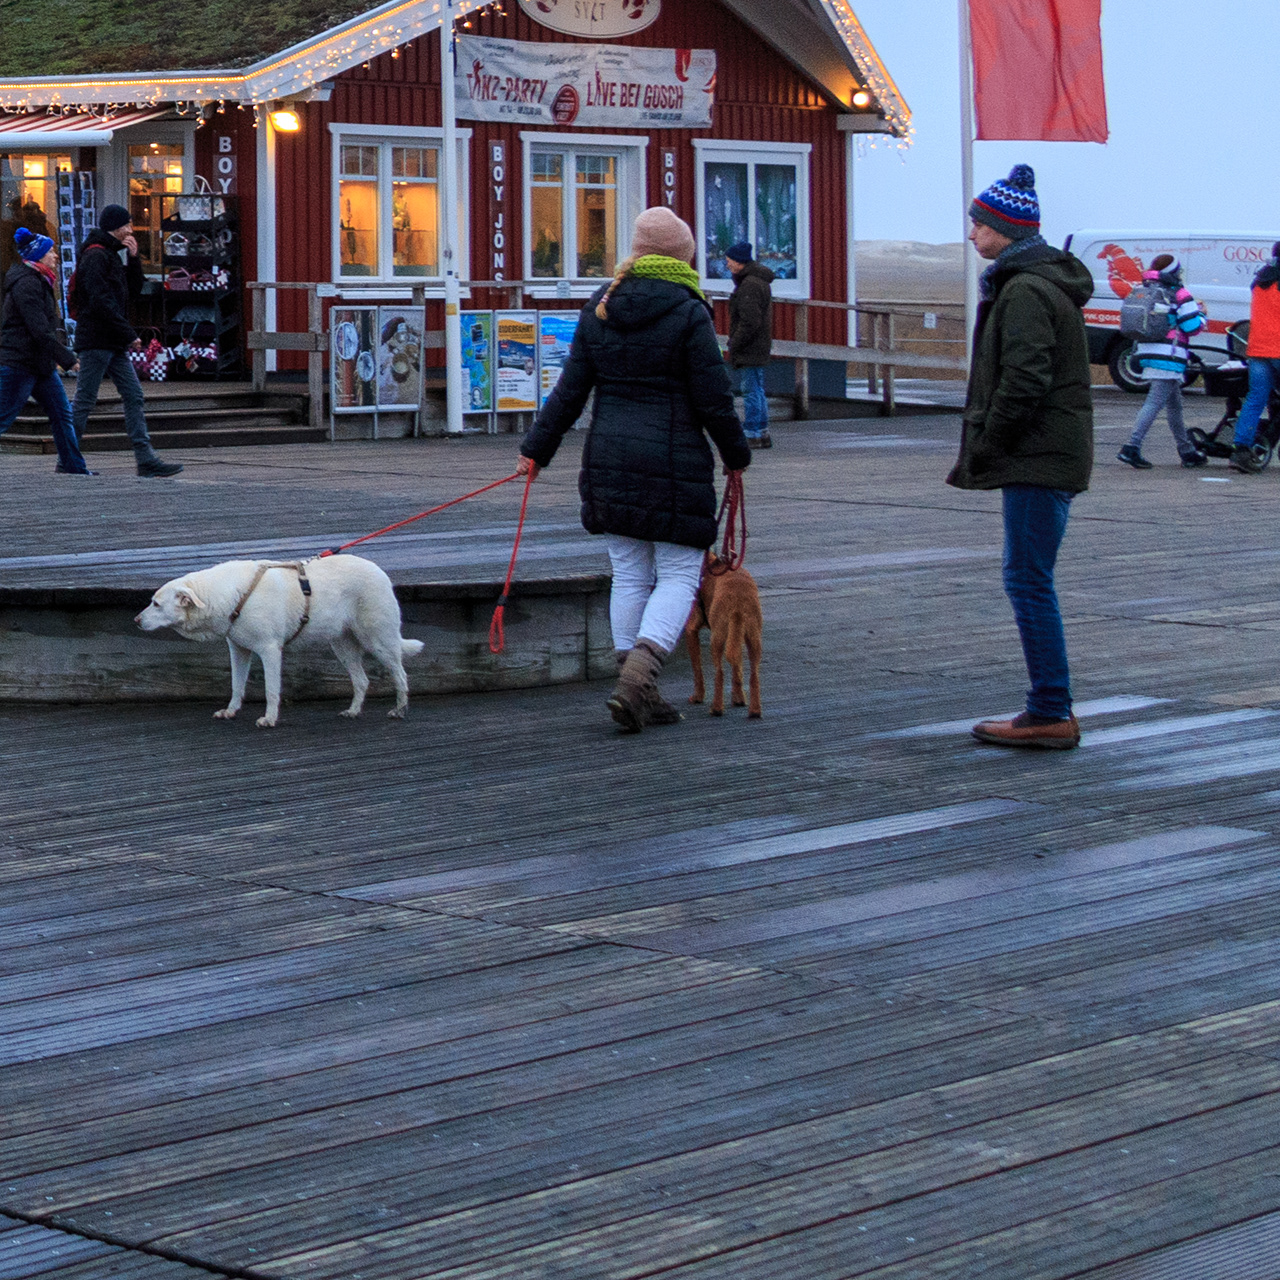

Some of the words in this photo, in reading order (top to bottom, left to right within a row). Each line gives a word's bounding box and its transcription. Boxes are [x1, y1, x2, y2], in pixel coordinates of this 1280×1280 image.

[574, 0, 606, 22] SYLT
[620, 82, 641, 108] BEI
[643, 83, 684, 109] GOSCH
[493, 146, 503, 201] BOY
[665, 153, 674, 205] BOY
